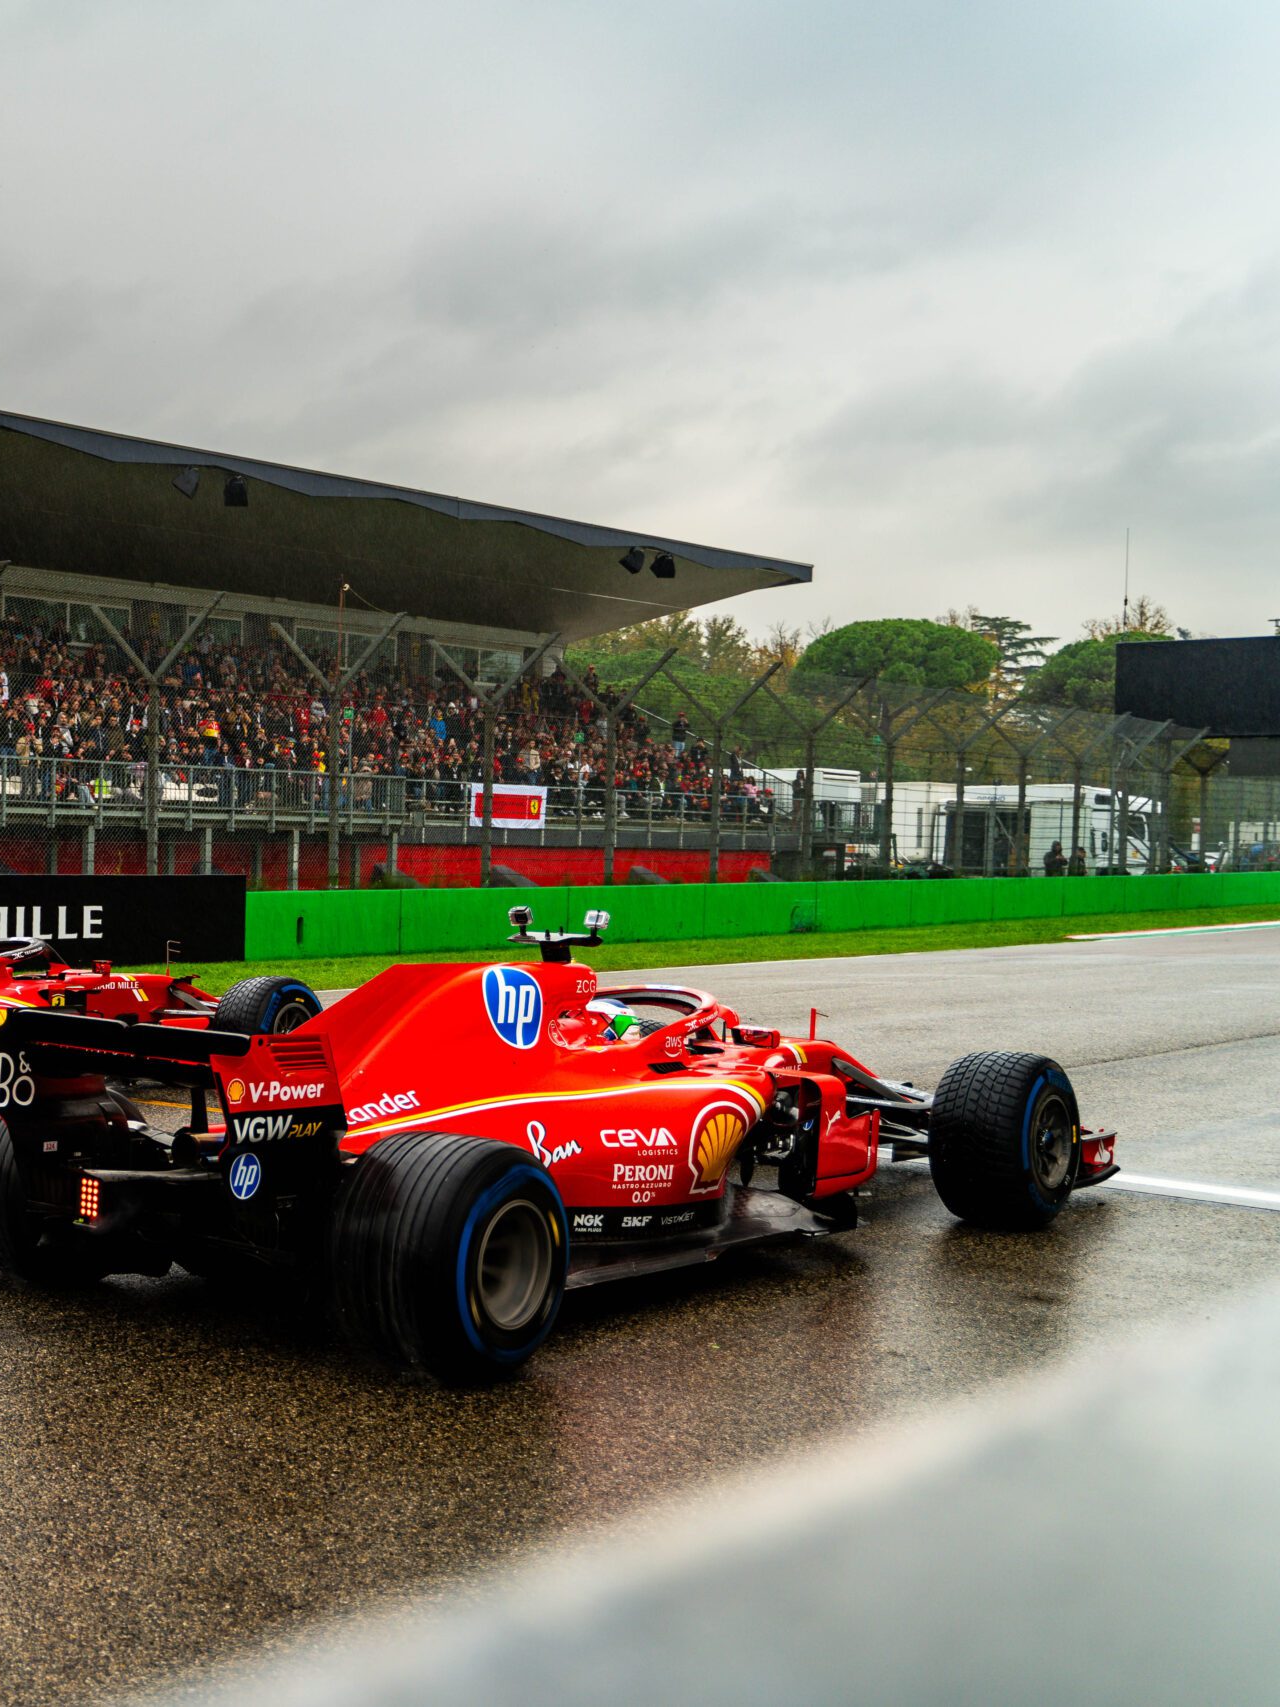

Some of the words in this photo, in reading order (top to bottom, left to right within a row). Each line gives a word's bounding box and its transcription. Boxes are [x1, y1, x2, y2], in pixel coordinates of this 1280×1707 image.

[493, 966, 536, 1048] hp
[249, 1080, 325, 1103] V-Power
[233, 1114, 293, 1144] VGW
[288, 1121, 322, 1139] PLAY
[234, 1153, 257, 1199] hp
[612, 1163, 674, 1182] PERONI
[573, 1214, 604, 1227] NGK
[621, 1215, 652, 1227] SKF
